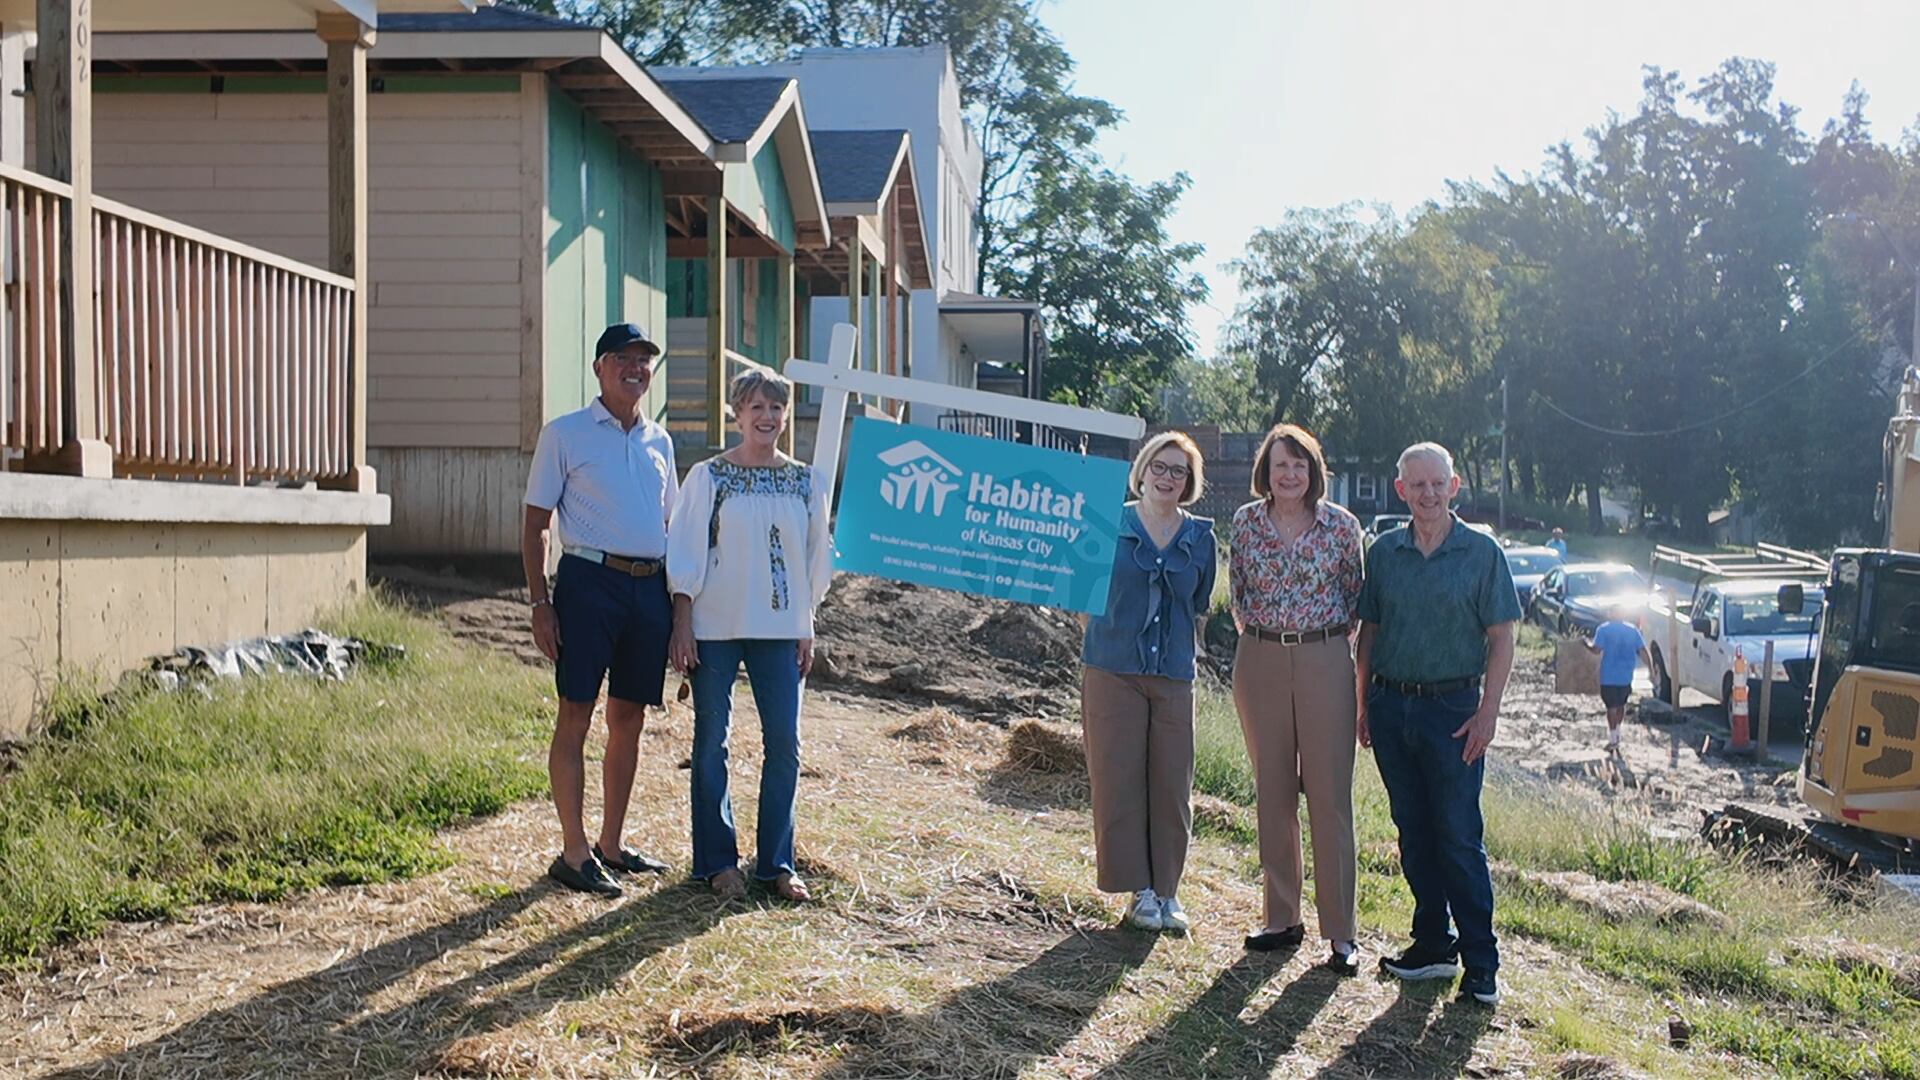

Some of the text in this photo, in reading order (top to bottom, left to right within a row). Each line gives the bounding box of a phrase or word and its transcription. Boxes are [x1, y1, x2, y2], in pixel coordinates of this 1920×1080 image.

[968, 472, 1085, 520] Habitat
[961, 527, 1054, 559] of Kansas City
[965, 504, 1080, 544] for Humanity
[881, 535, 900, 545] build
[960, 549, 976, 558] and
[1020, 559, 1049, 572] through
